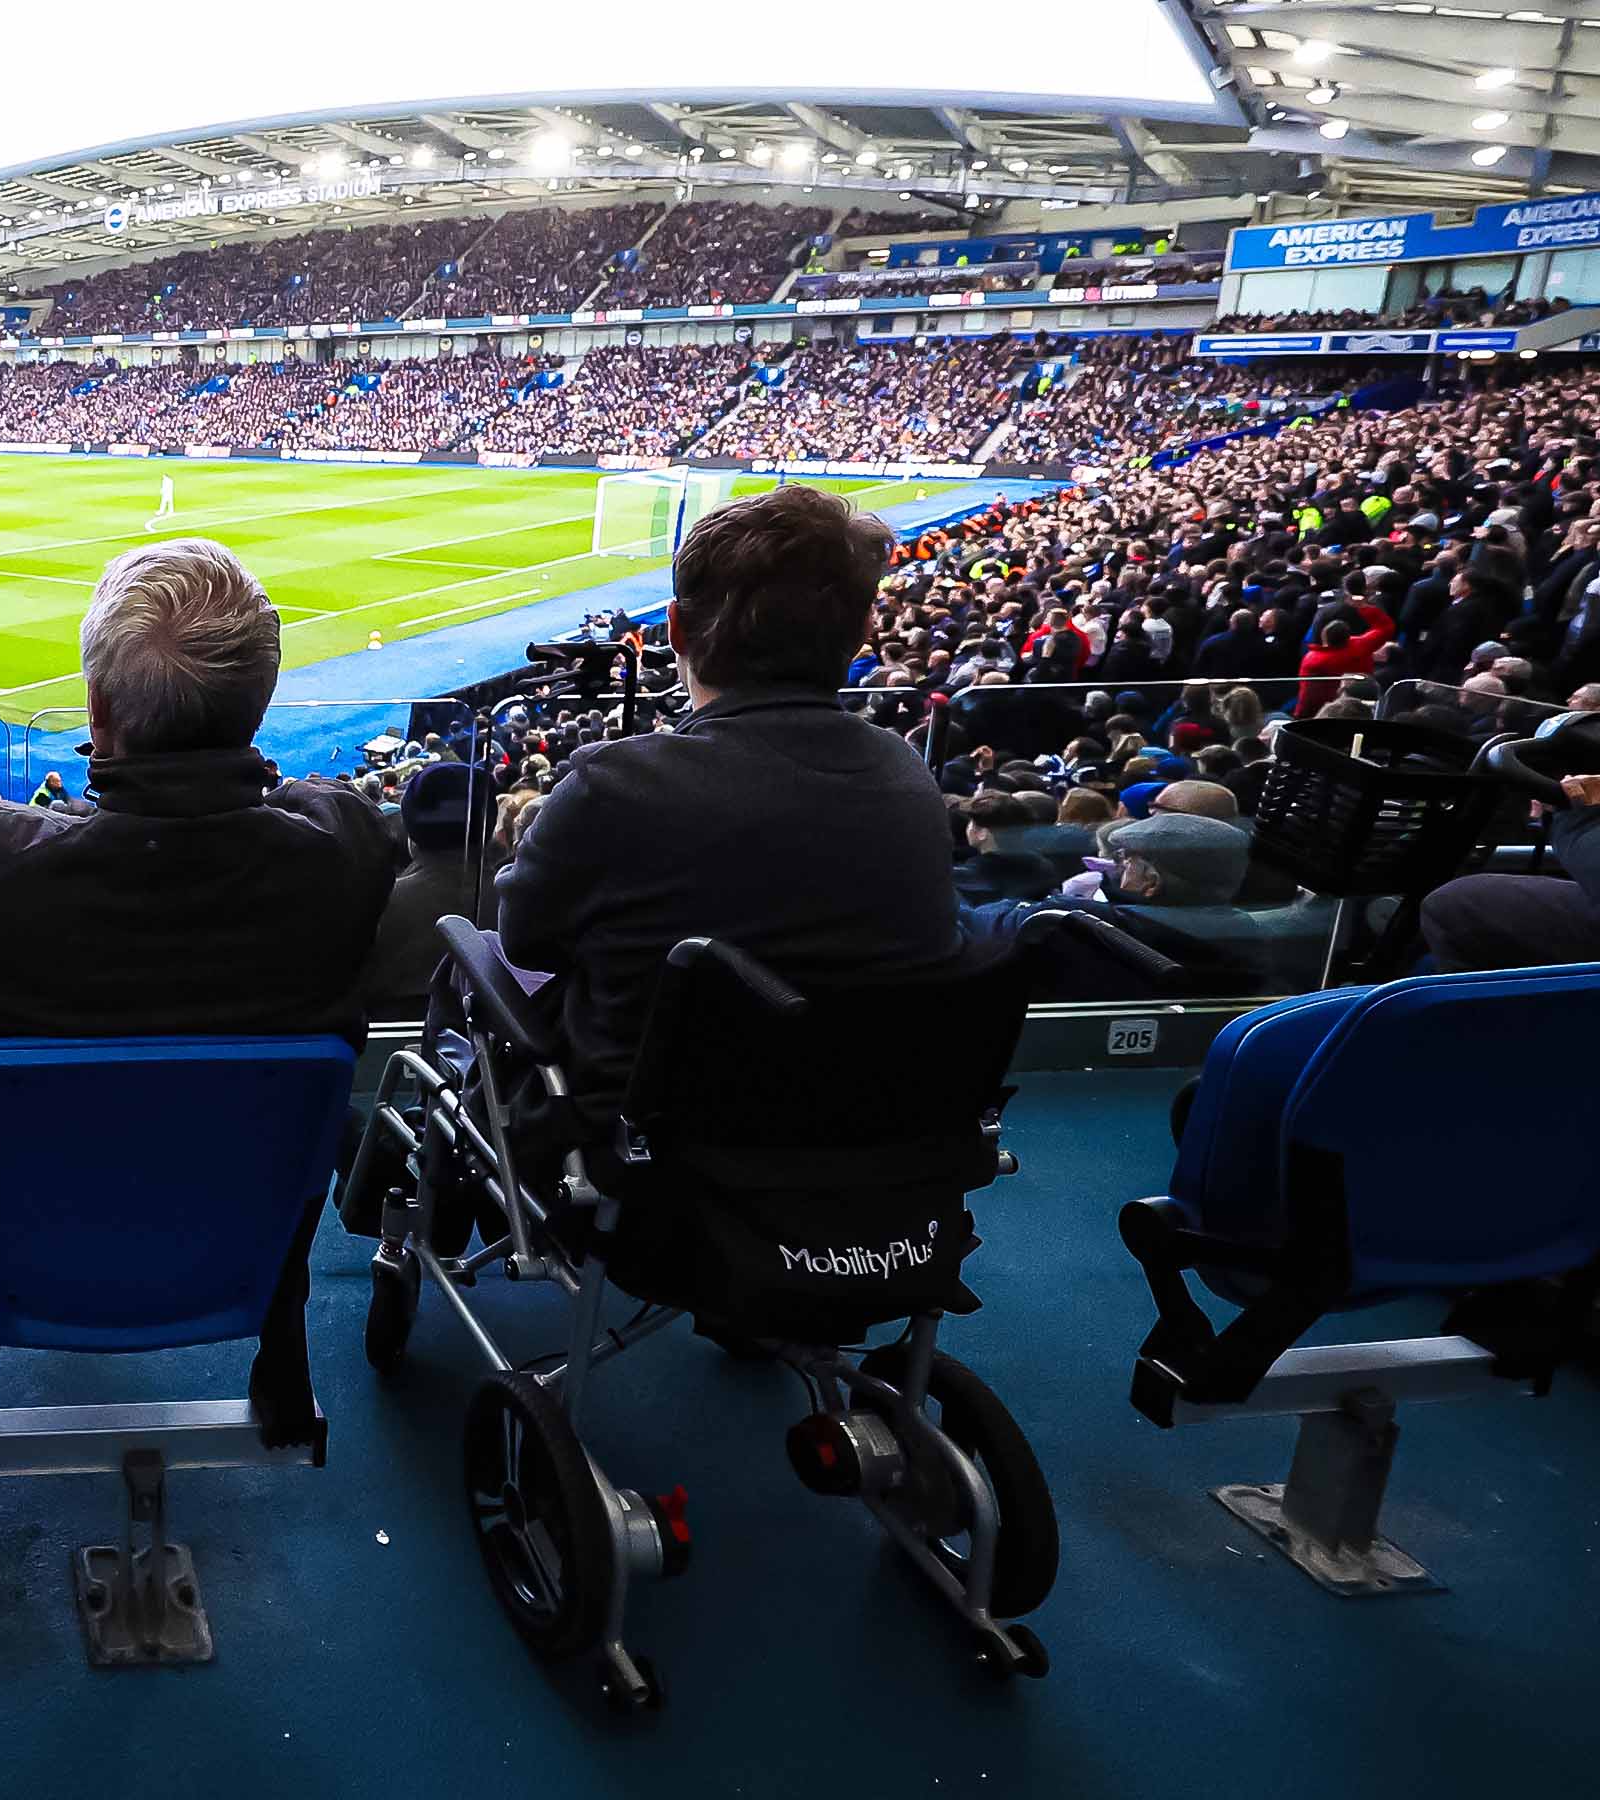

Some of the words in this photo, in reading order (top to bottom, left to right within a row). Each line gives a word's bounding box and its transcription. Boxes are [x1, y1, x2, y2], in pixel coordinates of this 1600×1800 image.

[135, 195, 218, 223] AMERICAN
[222, 188, 301, 212] EXPRESS
[306, 175, 381, 202] STADIUM
[1268, 219, 1408, 248] AMERICAN
[1517, 220, 1600, 247] EXPRESS
[1284, 239, 1405, 264] EXPRESS
[1111, 1030, 1153, 1049] 205
[778, 1238, 934, 1280] MobilityPlus
